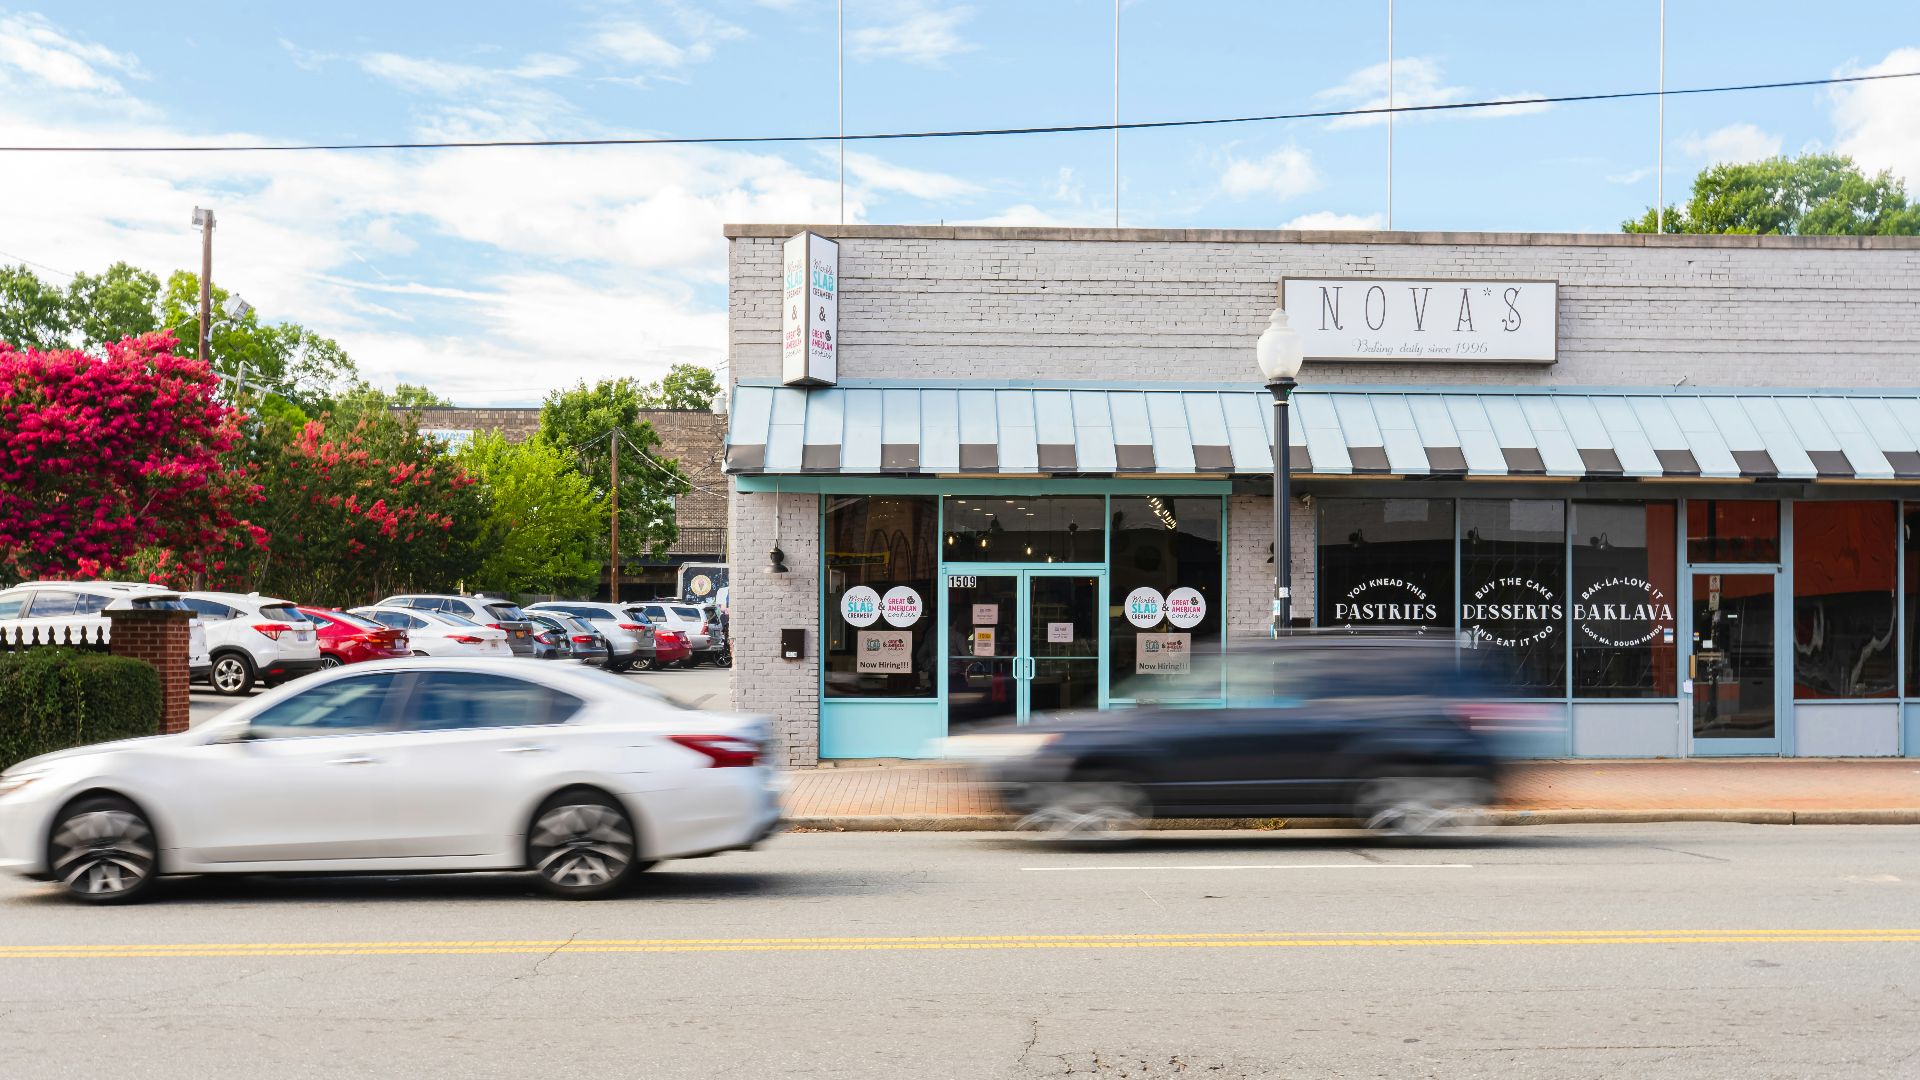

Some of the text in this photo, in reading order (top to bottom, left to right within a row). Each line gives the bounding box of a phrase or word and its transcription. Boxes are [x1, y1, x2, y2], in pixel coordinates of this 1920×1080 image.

[813, 270, 834, 292] SLAB
[819, 306, 826, 321] &
[1352, 338, 1488, 355] Baking daily since 1996
[950, 576, 976, 587] 1509
[1347, 578, 1426, 600] YOU KNEAD THIS
[1474, 577, 1553, 600] BUY THE CAKE
[1581, 577, 1664, 600] BAK-LA-LOVE IT
[848, 602, 874, 612] SLAB
[878, 601, 885, 611] &
[1131, 603, 1157, 613] SLAB
[1162, 602, 1169, 611] &
[1335, 603, 1437, 620] PASTRIES
[1462, 604, 1563, 620] DESSERTS
[1573, 603, 1674, 620] BAKLAVA
[1472, 624, 1553, 647] AND EAT IT TOO
[1581, 624, 1598, 640] LOOK
[1614, 638, 1640, 647] DOUGH
[1641, 624, 1663, 643] HANDS
[879, 661, 909, 669] Hiring!!!
